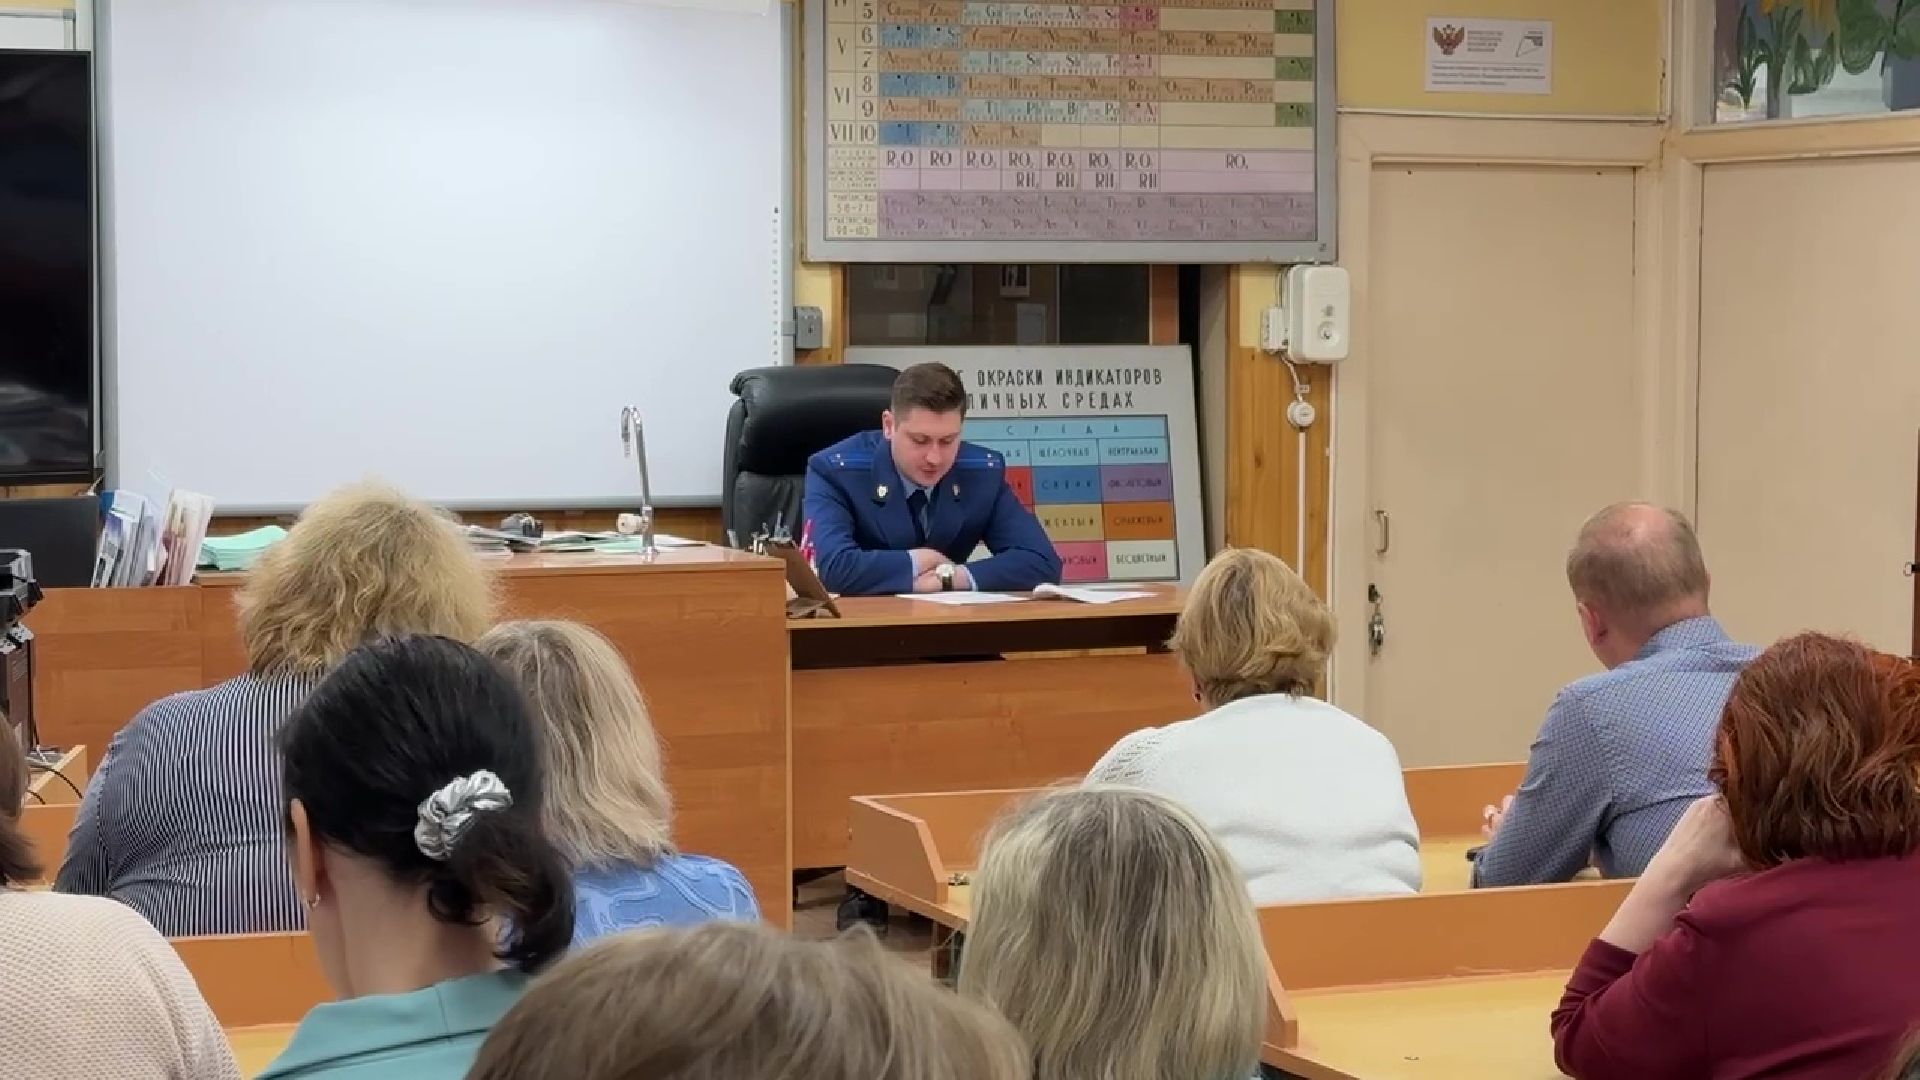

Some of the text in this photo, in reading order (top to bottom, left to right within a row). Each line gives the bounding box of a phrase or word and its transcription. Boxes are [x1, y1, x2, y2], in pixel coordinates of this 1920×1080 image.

[863, 2, 873, 19] 5
[861, 26, 873, 43] 6
[837, 37, 847, 55] V
[863, 51, 873, 68] 7
[862, 75, 872, 93] 8
[834, 87, 850, 104] VI
[862, 100, 874, 117] 9
[831, 123, 853, 142] VII
[860, 124, 875, 142] 10
[930, 150, 952, 167] RO
[977, 369, 1043, 387] ОКРАСКИ
[1056, 368, 1162, 387] ИНДИКАТОРОВ
[965, 391, 1133, 410] ЛИЧНЫХ СРЕДАХ
